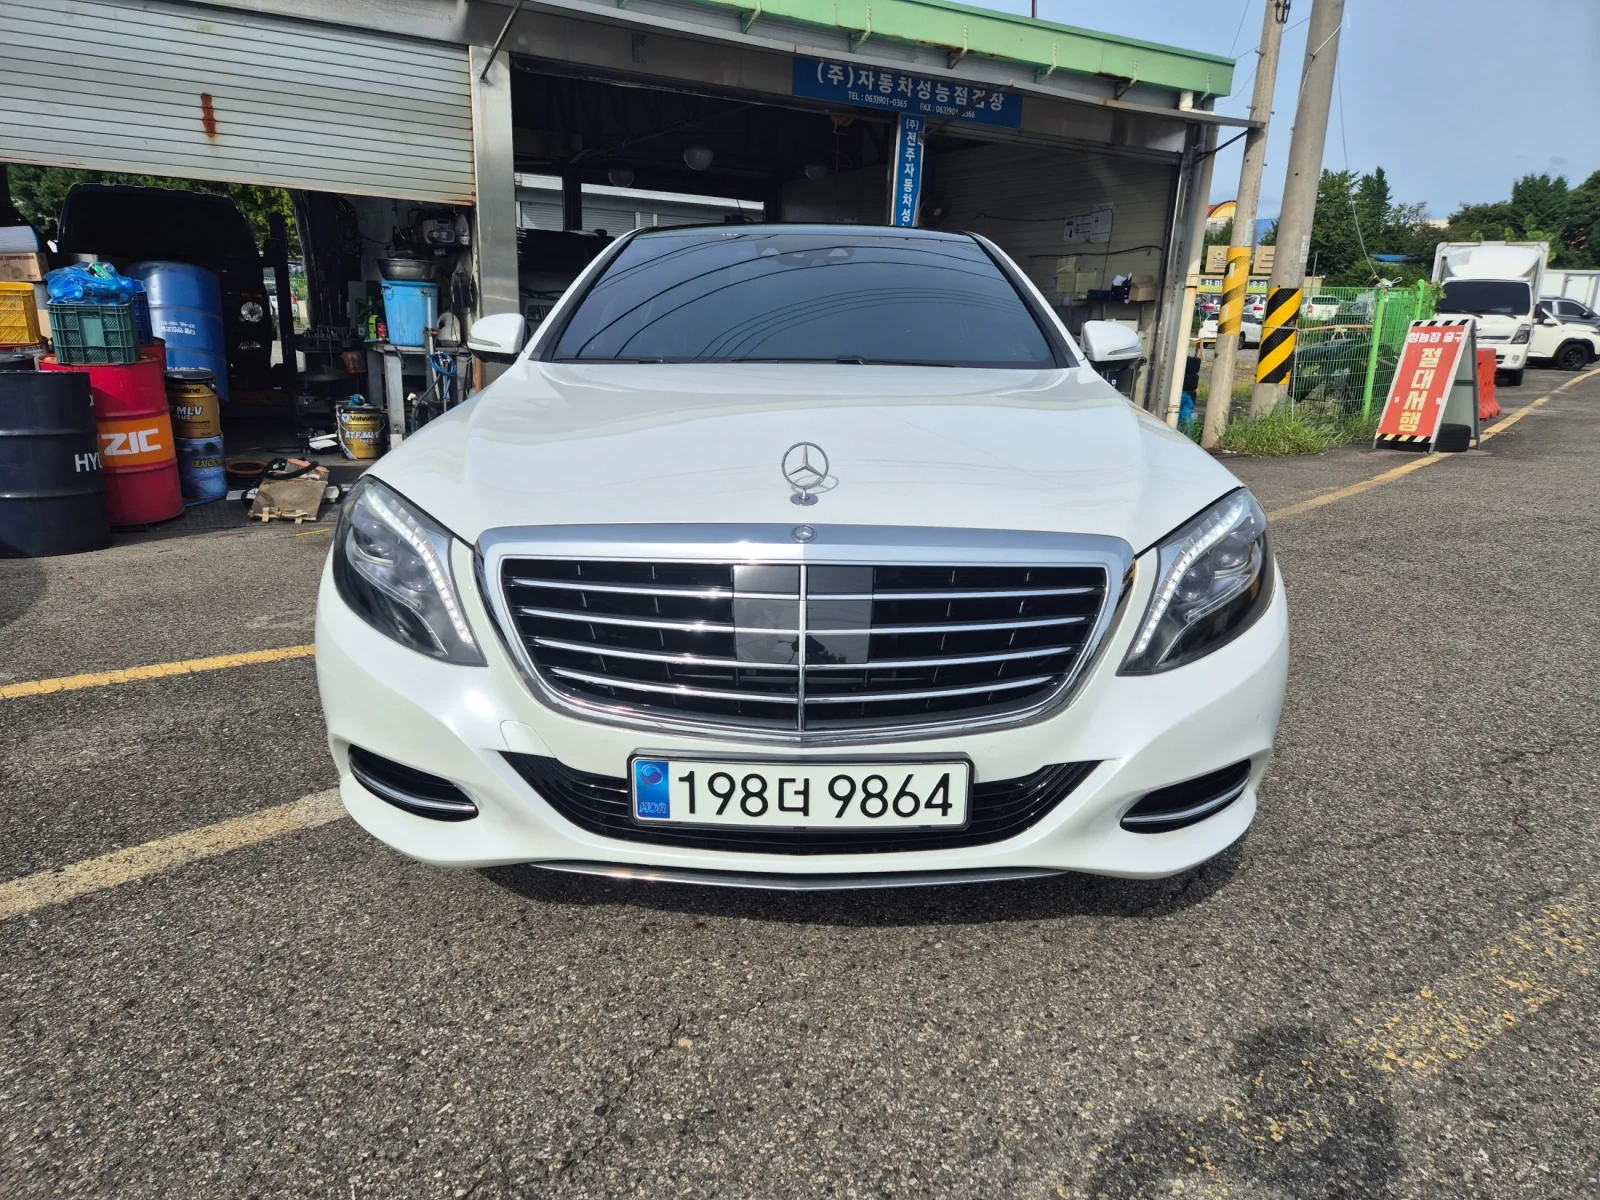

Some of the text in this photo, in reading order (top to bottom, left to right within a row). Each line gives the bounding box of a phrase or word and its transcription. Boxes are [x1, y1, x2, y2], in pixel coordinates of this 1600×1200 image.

[847, 91, 859, 101] TEL
[920, 103, 931, 112] FAX
[1398, 347, 1443, 432] 절대서행
[101, 428, 161, 456] ZIC
[678, 770, 953, 819] 198더 9864
[639, 801, 667, 814] KOR
